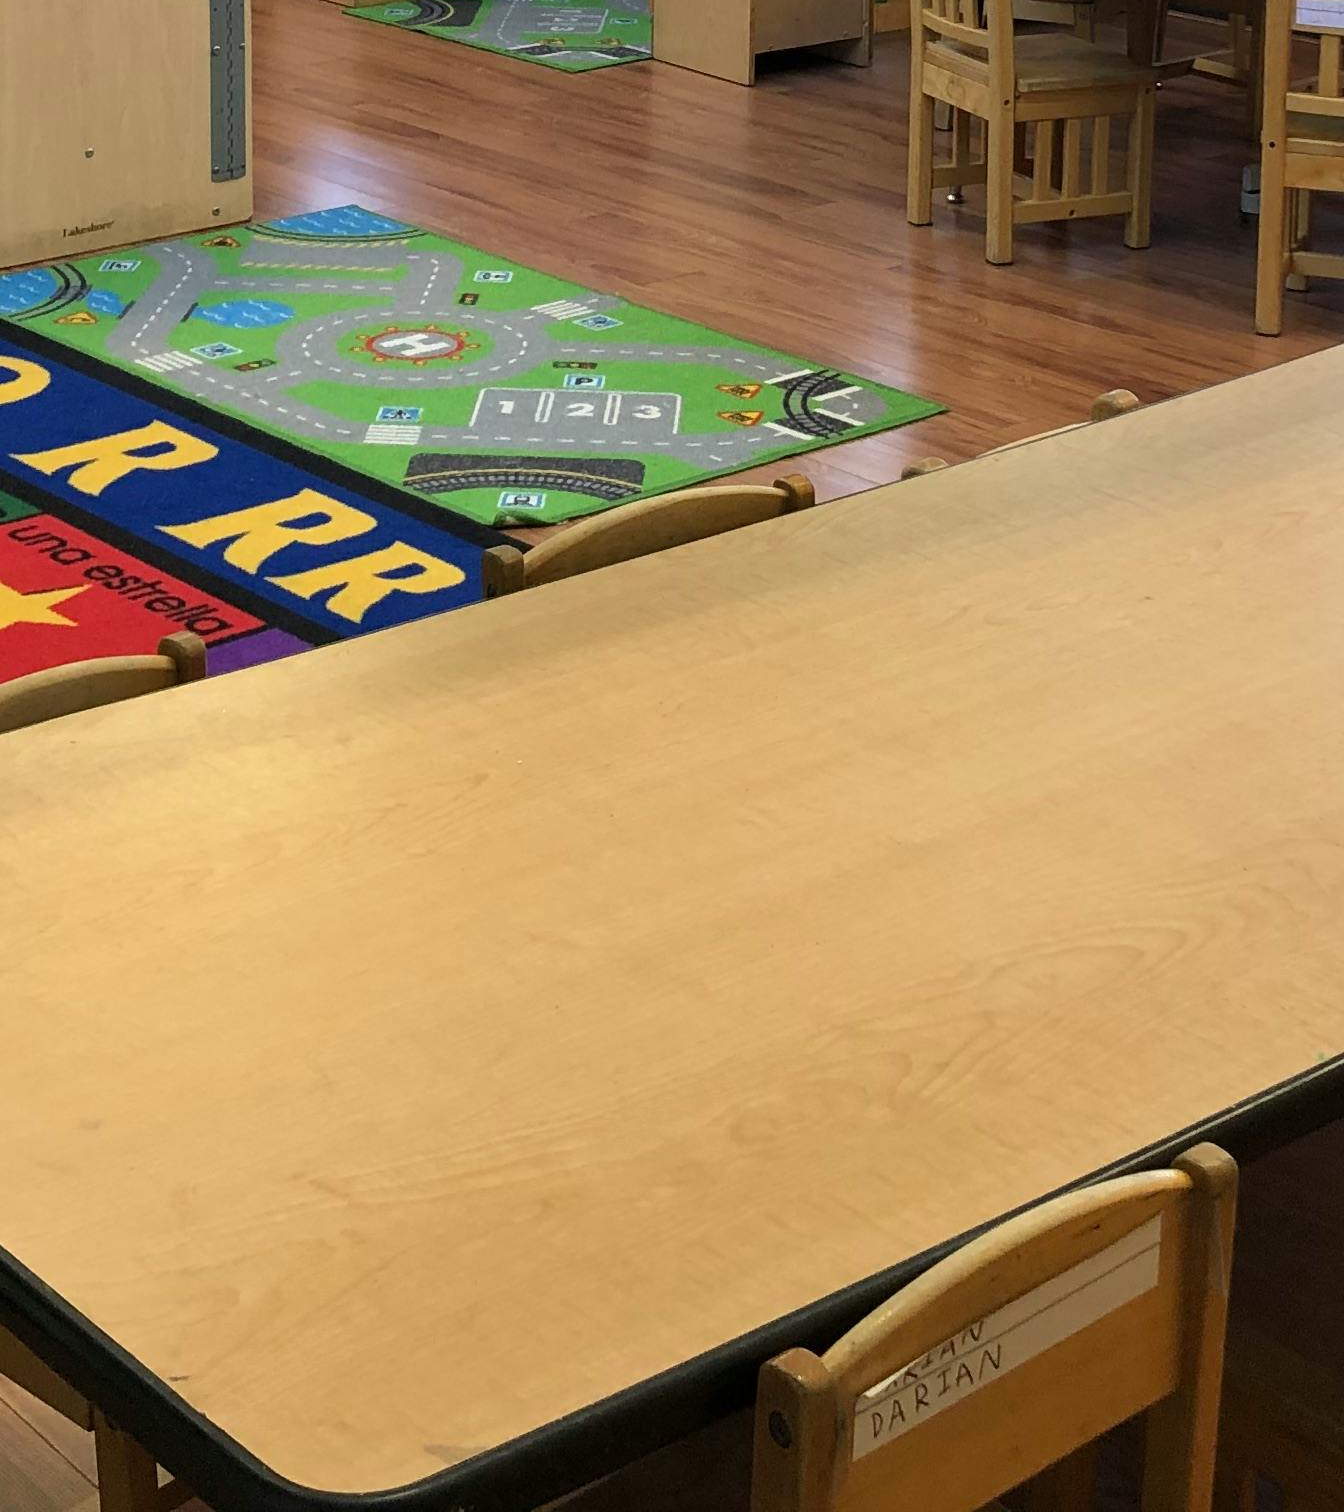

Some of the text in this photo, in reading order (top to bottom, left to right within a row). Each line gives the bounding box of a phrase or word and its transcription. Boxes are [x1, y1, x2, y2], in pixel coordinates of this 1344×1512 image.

[380, 333, 450, 355] H
[499, 400, 661, 418] 1 2 3
[8, 419, 220, 496] R
[155, 488, 466, 623] RR
[8, 525, 235, 636] una estrella
[871, 1343, 1001, 1438] DARIAN
